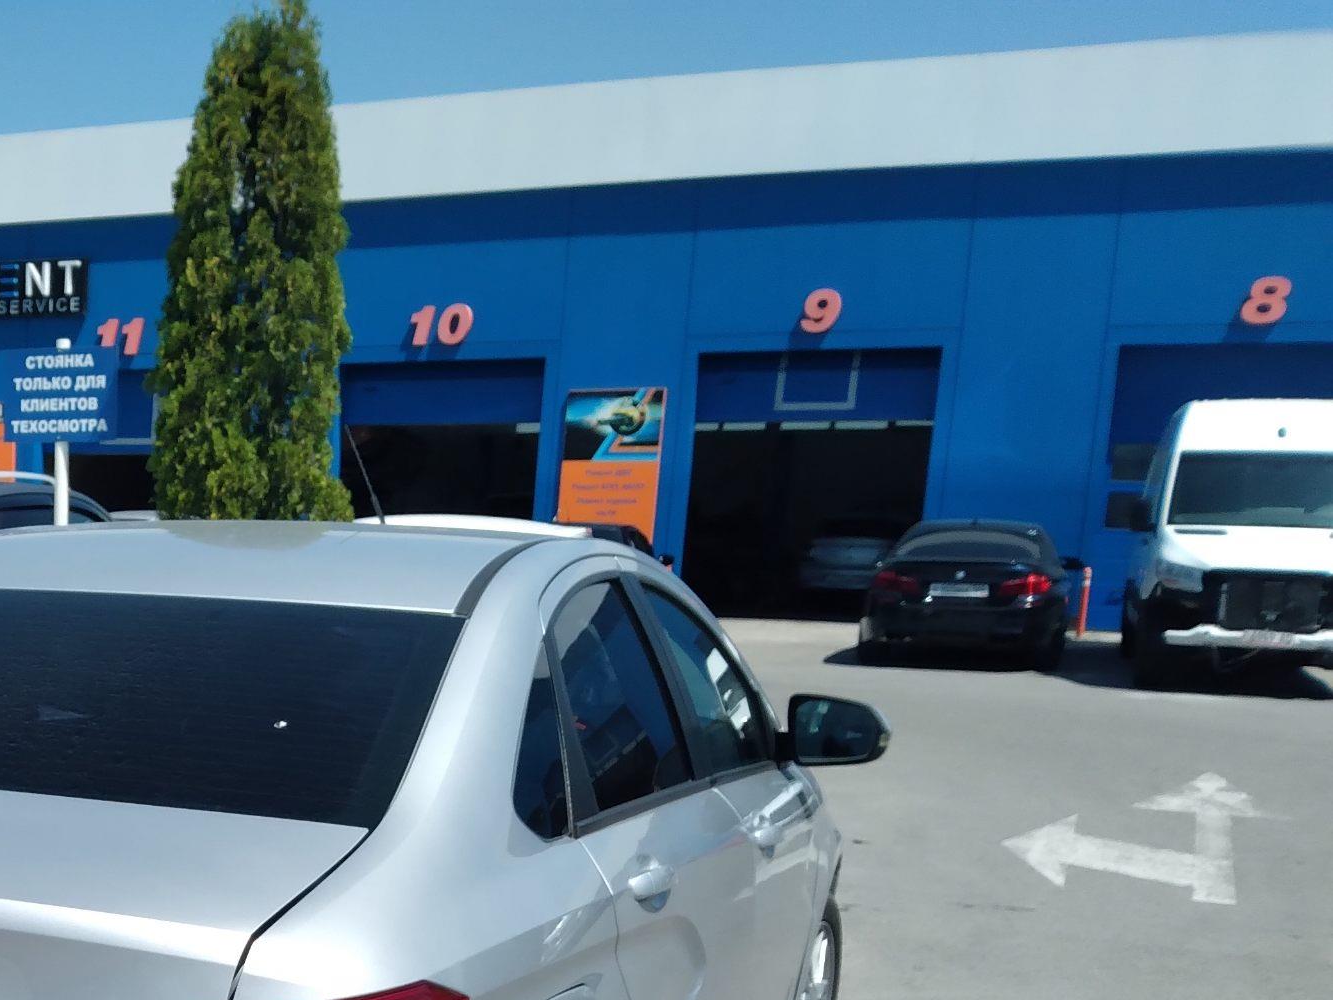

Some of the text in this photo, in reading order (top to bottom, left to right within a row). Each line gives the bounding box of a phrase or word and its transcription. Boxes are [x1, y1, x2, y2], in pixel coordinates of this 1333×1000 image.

[800, 288, 842, 334] 9
[1240, 275, 1293, 325] 8
[97, 317, 145, 356] 11
[410, 302, 474, 346] 10
[25, 353, 95, 370] СТОЯНКА
[12, 374, 107, 392] ТОЛЬКО ДЛЯ
[20, 397, 99, 413] КЛИЕНТОВ
[10, 418, 108, 434] ТЕХОСМОТРА
